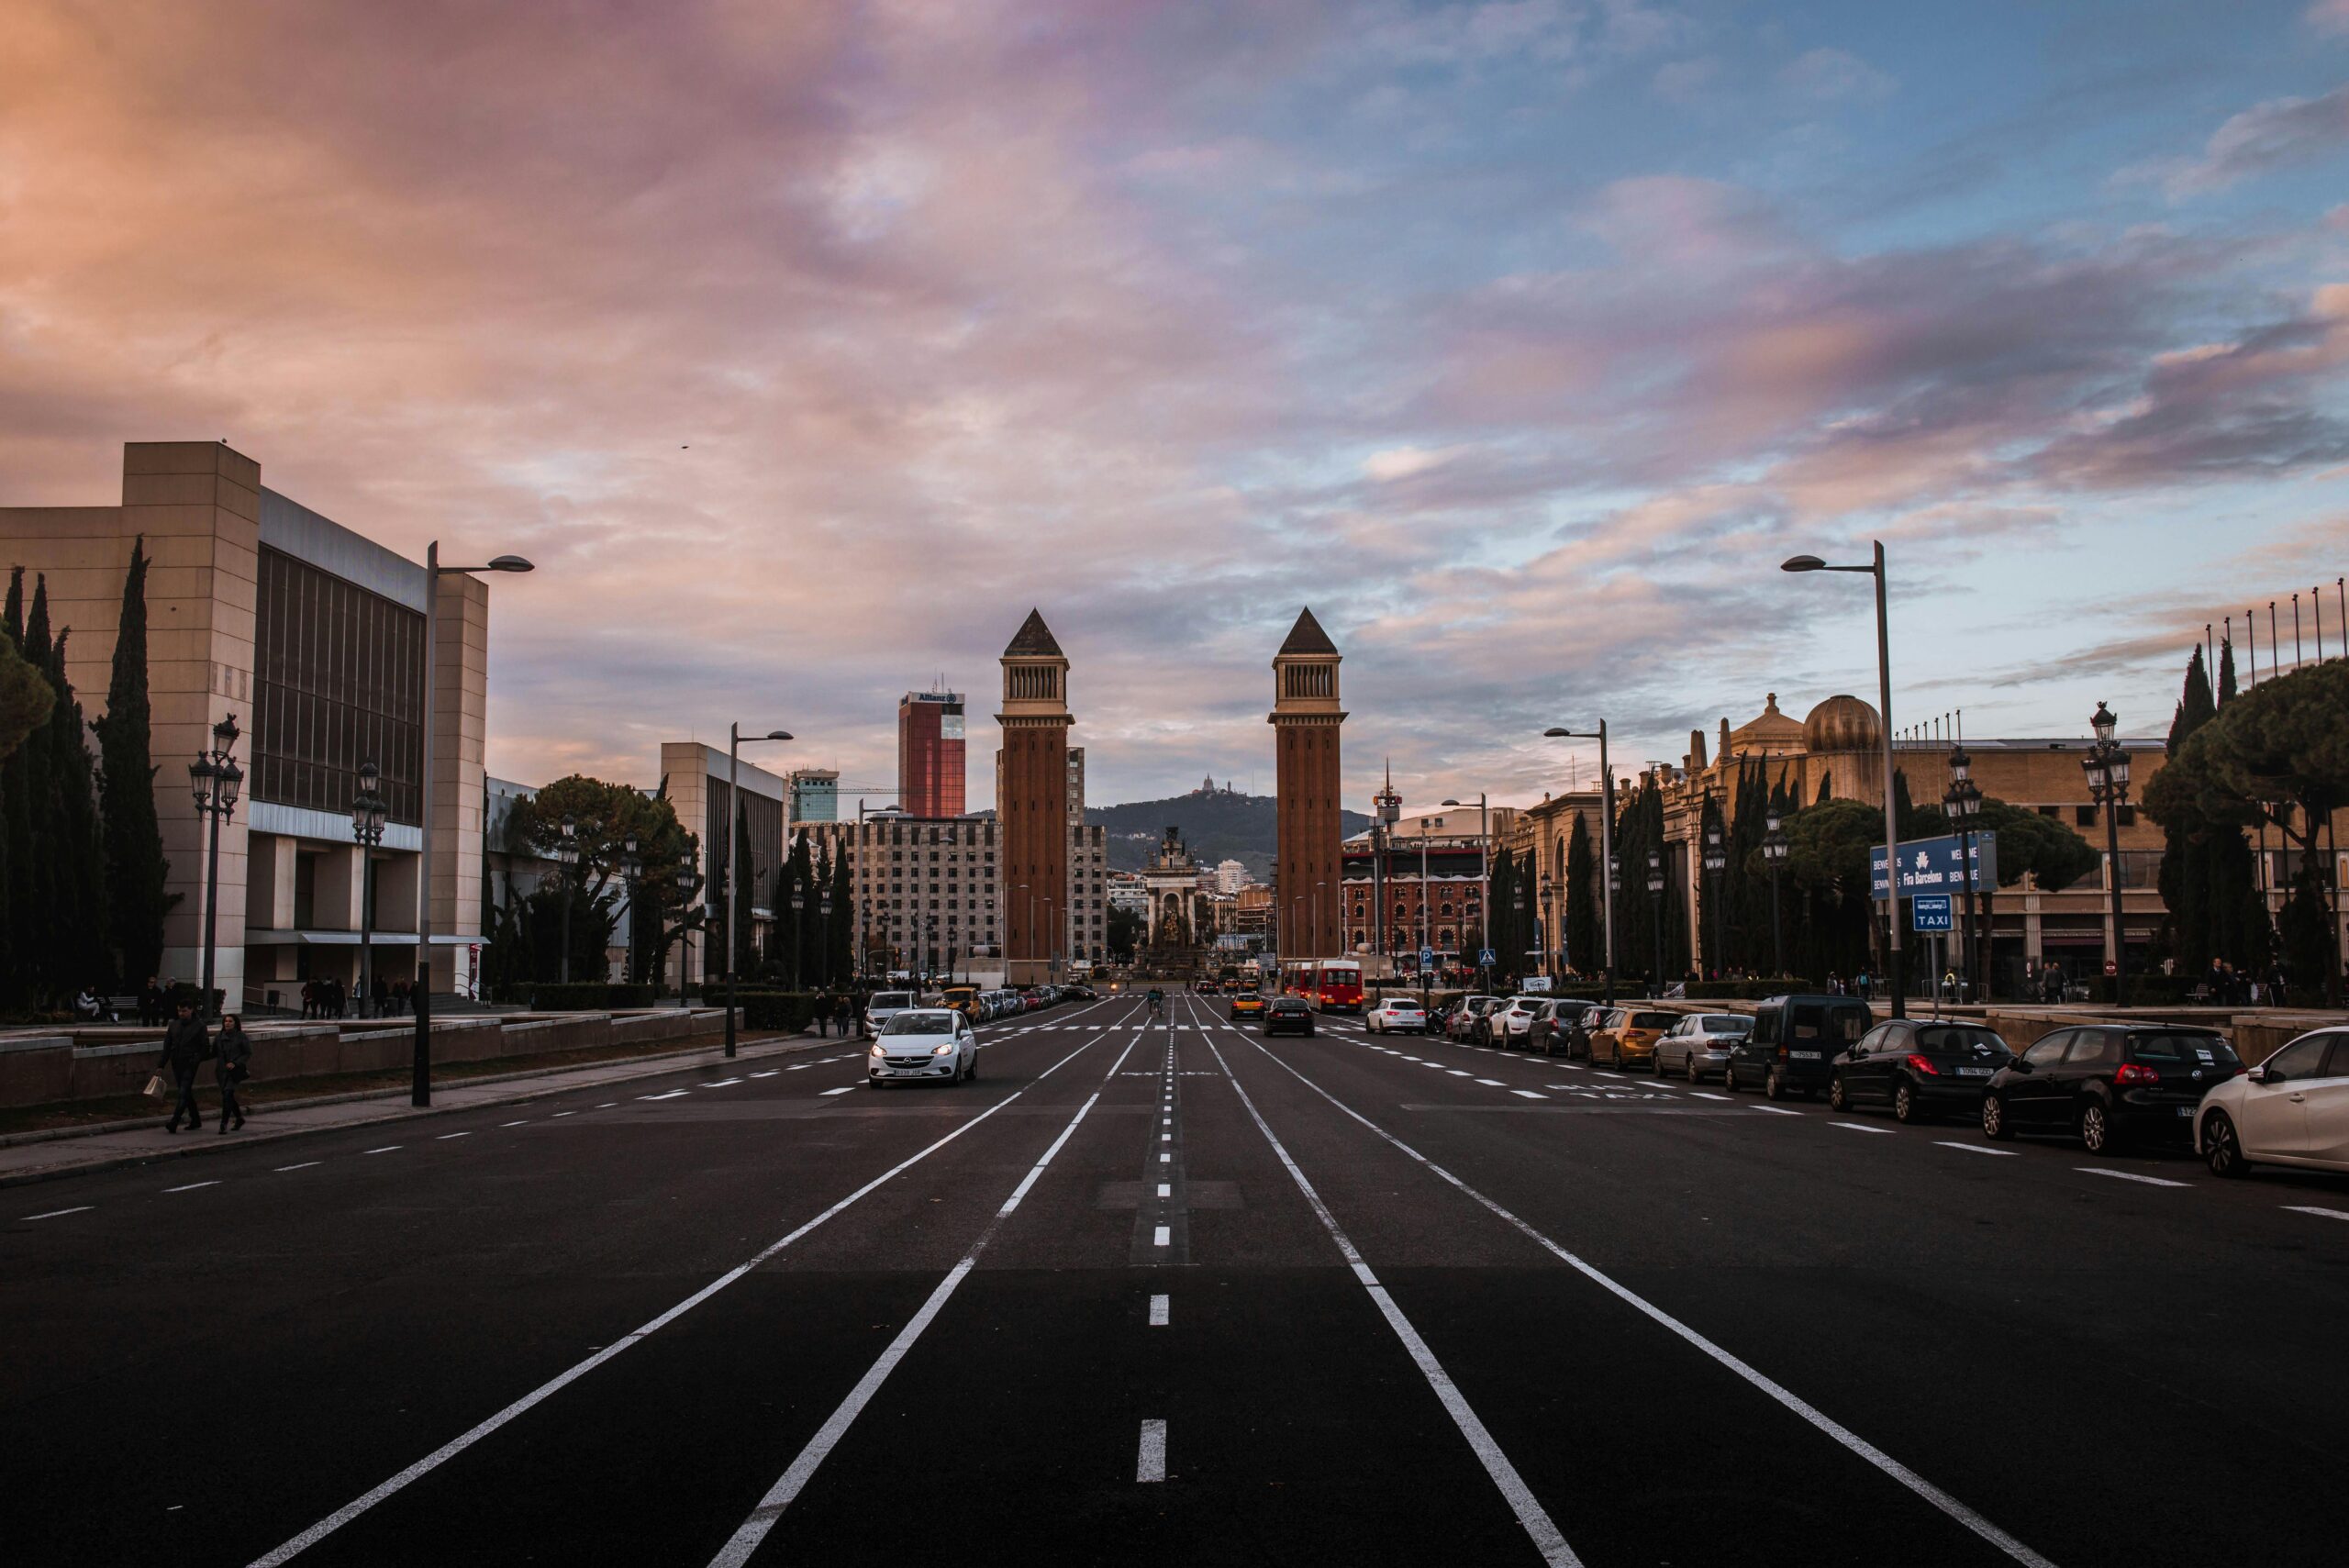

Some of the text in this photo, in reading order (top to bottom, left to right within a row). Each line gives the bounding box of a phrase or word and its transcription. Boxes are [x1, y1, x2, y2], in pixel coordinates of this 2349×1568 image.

[918, 694, 946, 702] Allianz
[1951, 847, 1977, 861] WELME
[1903, 870, 1943, 886] Fira Barcelona
[1949, 869, 1979, 883] BIENVUE
[1918, 916, 1948, 926] TAXI
[1423, 952, 1431, 962] P
